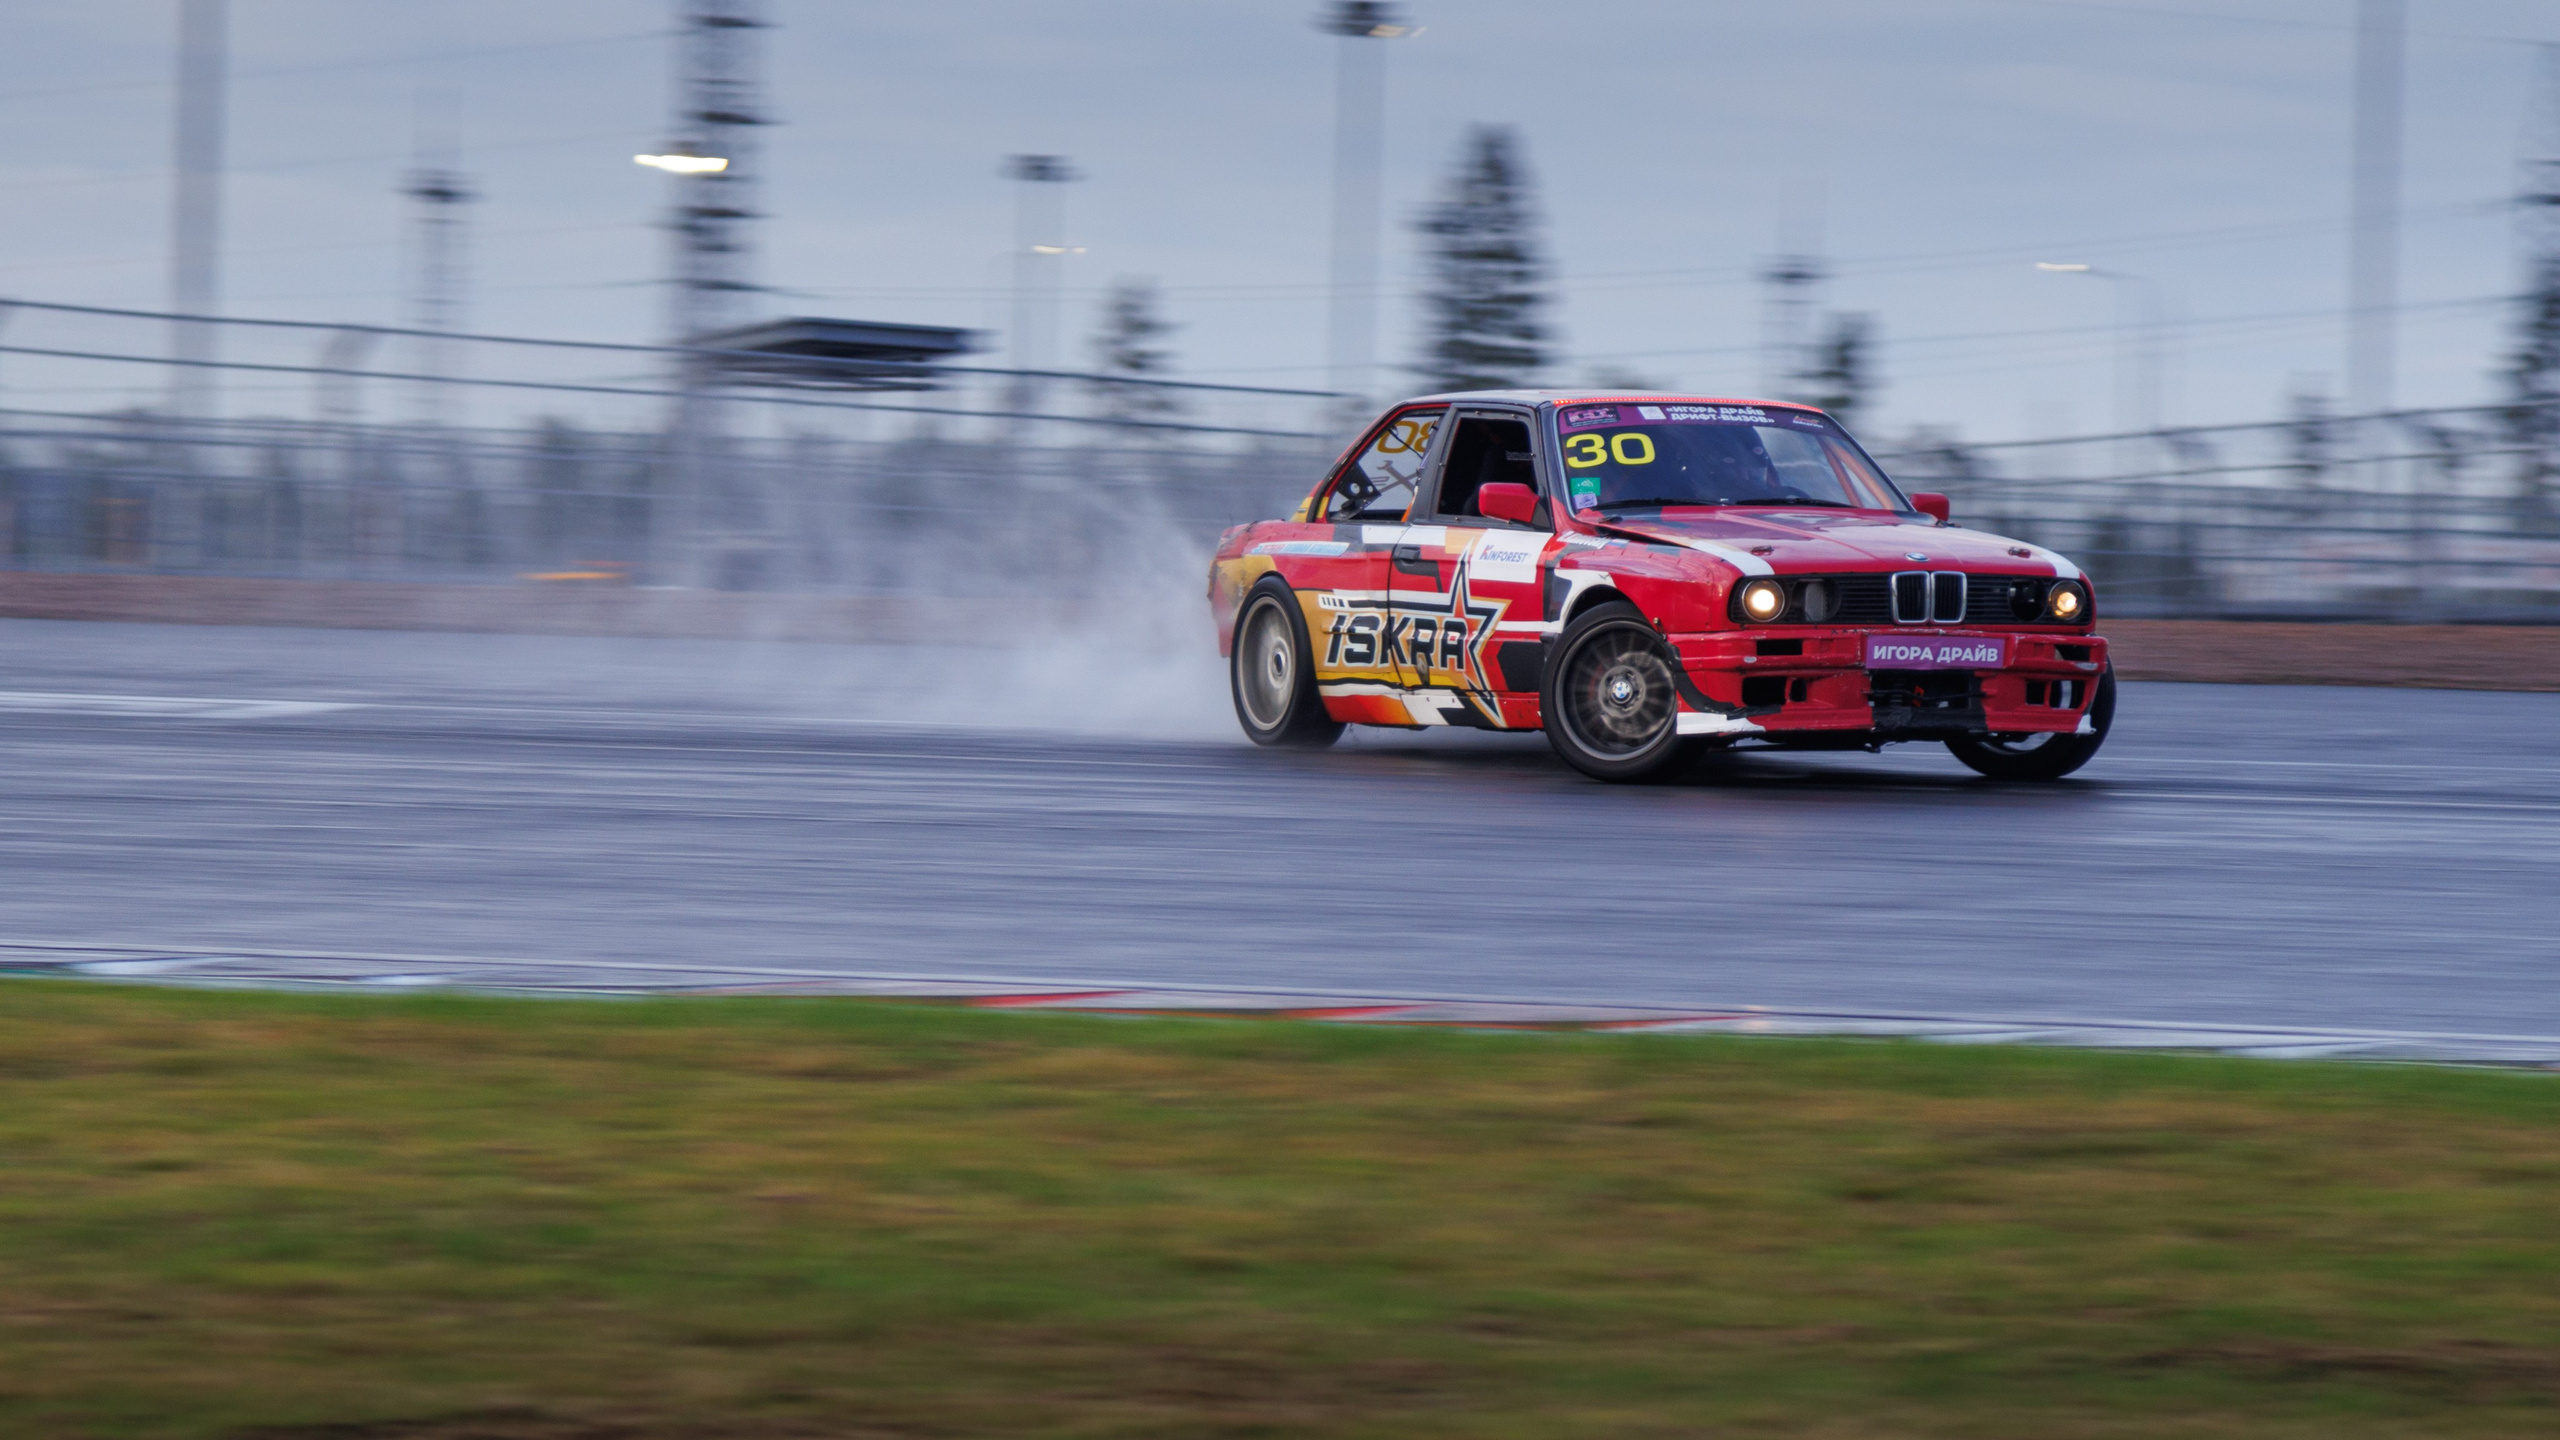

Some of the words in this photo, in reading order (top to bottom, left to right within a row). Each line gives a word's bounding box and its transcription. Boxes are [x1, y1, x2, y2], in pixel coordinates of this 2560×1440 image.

[1719, 406, 1766, 416] ДРАЙВ
[1566, 432, 1656, 468] 30
[1325, 612, 1468, 672] ISKRA
[1873, 645, 1934, 661] ИГОРА
[1936, 644, 1998, 663] ДРАЙВ
